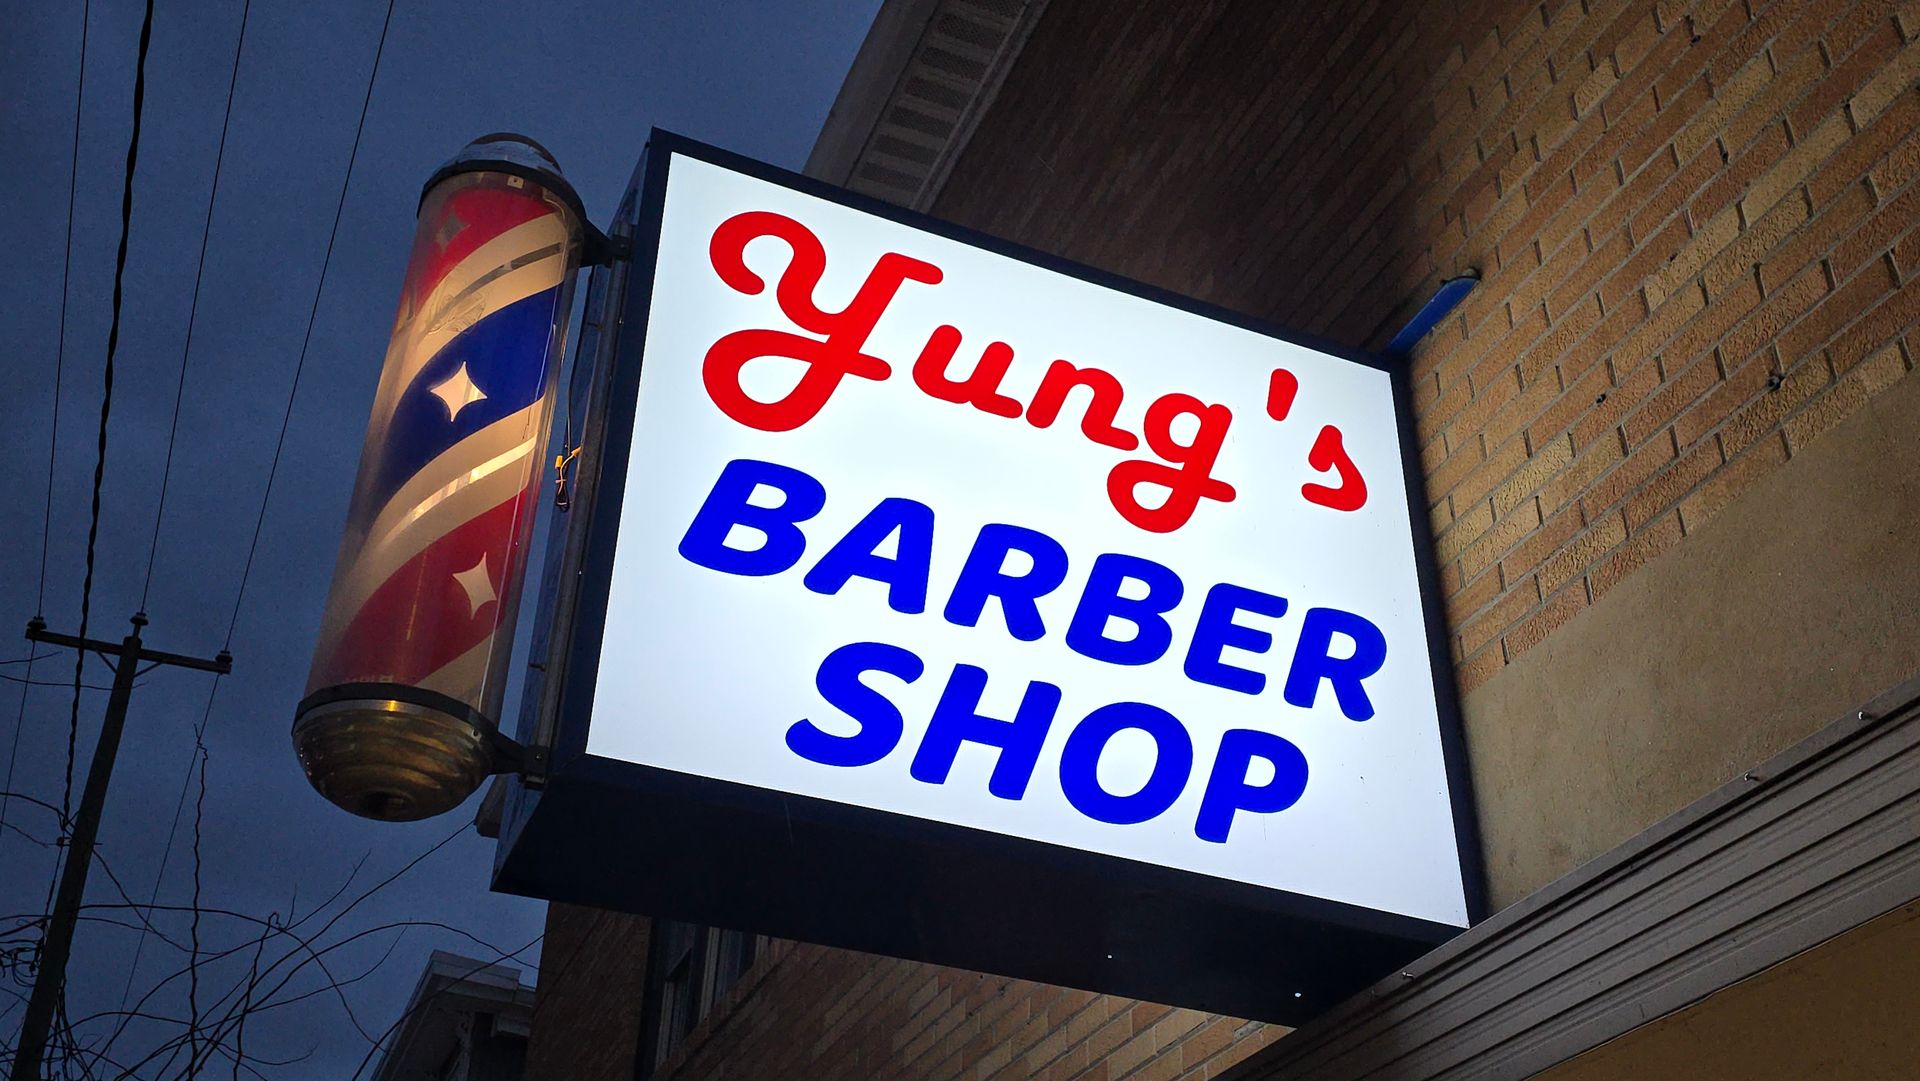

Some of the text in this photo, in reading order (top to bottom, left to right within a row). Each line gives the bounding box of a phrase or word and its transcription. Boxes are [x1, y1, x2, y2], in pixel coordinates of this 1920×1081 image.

[703, 212, 1367, 533] Yung's
[678, 459, 1386, 722] BARBER
[785, 642, 1308, 843] SHOP
